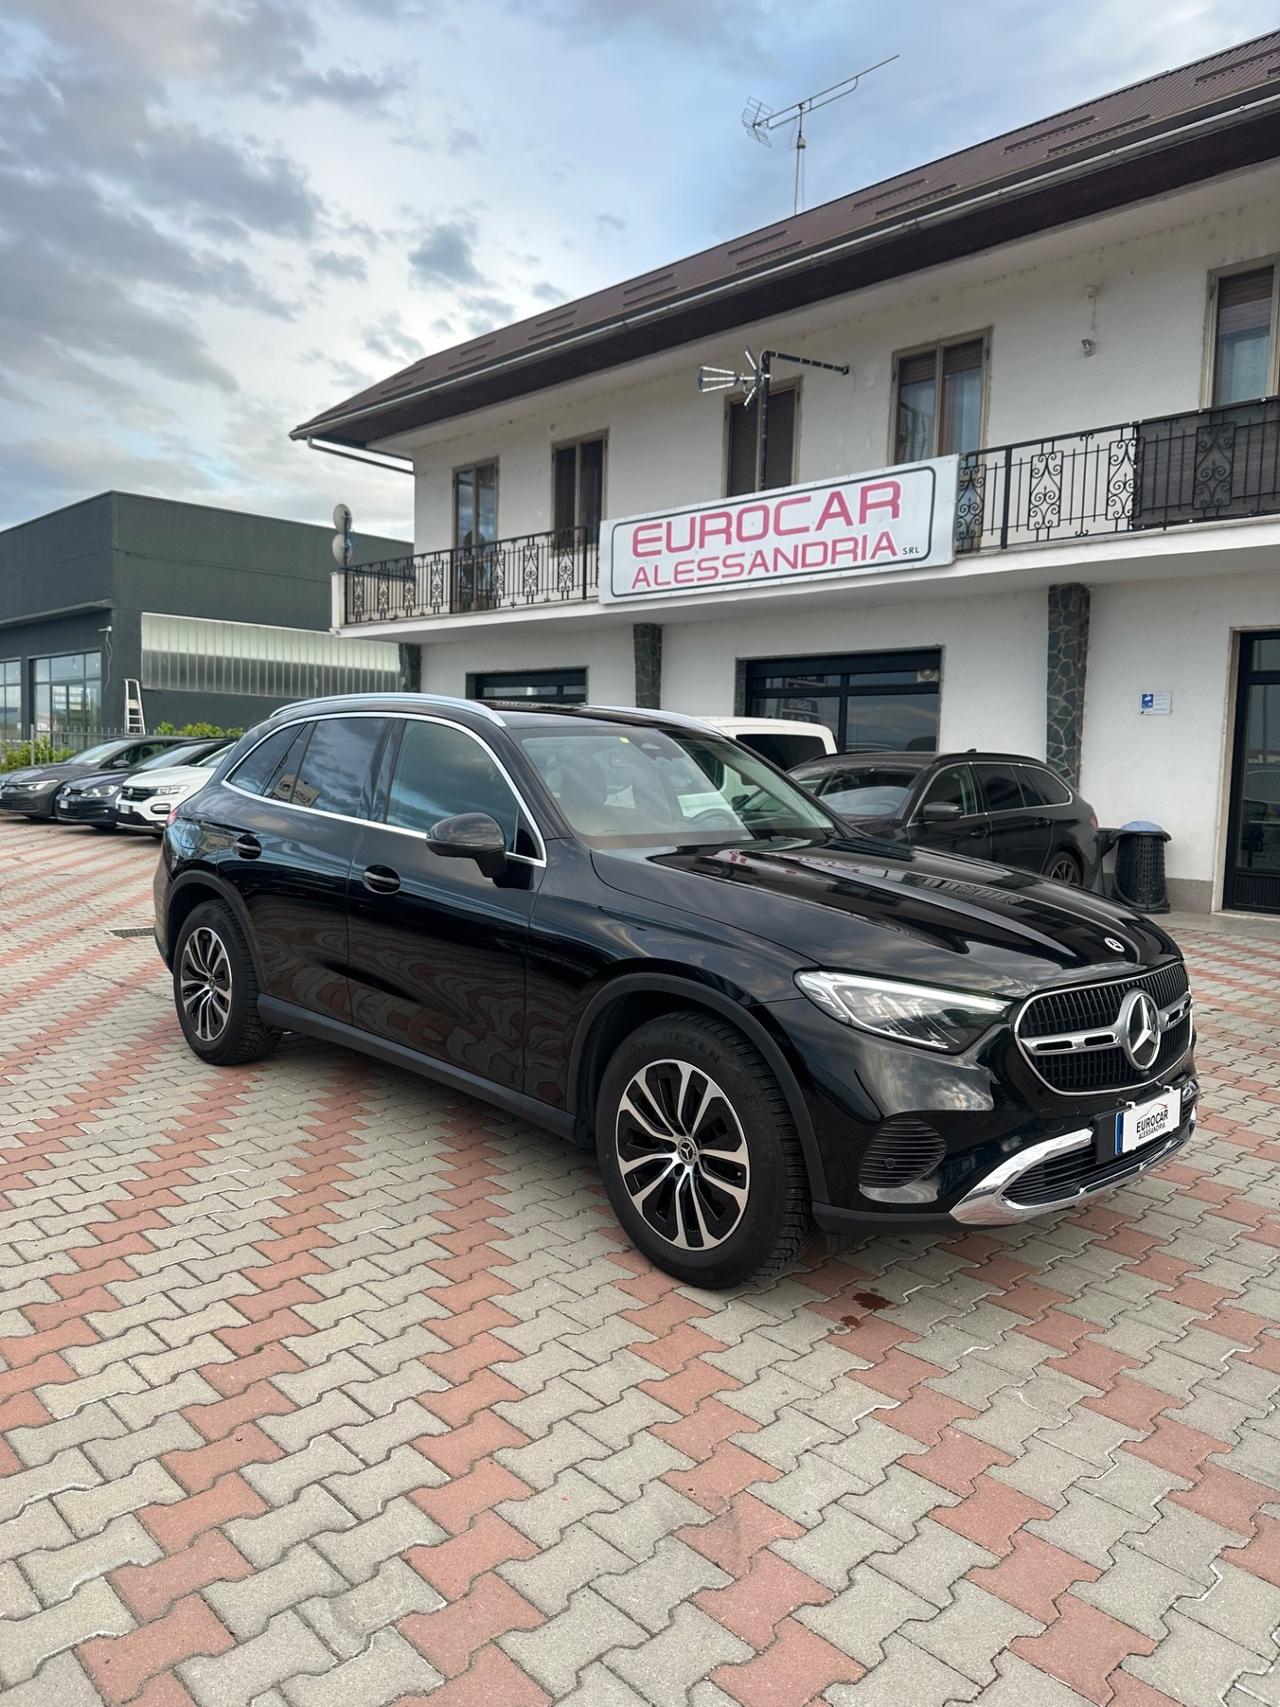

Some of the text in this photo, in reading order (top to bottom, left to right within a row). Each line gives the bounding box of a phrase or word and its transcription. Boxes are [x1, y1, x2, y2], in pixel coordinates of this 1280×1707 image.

[632, 480, 901, 558] EUROCAR
[631, 531, 920, 589] ALESSANDRIA SRL
[1136, 1109, 1169, 1133] EUROCAR
